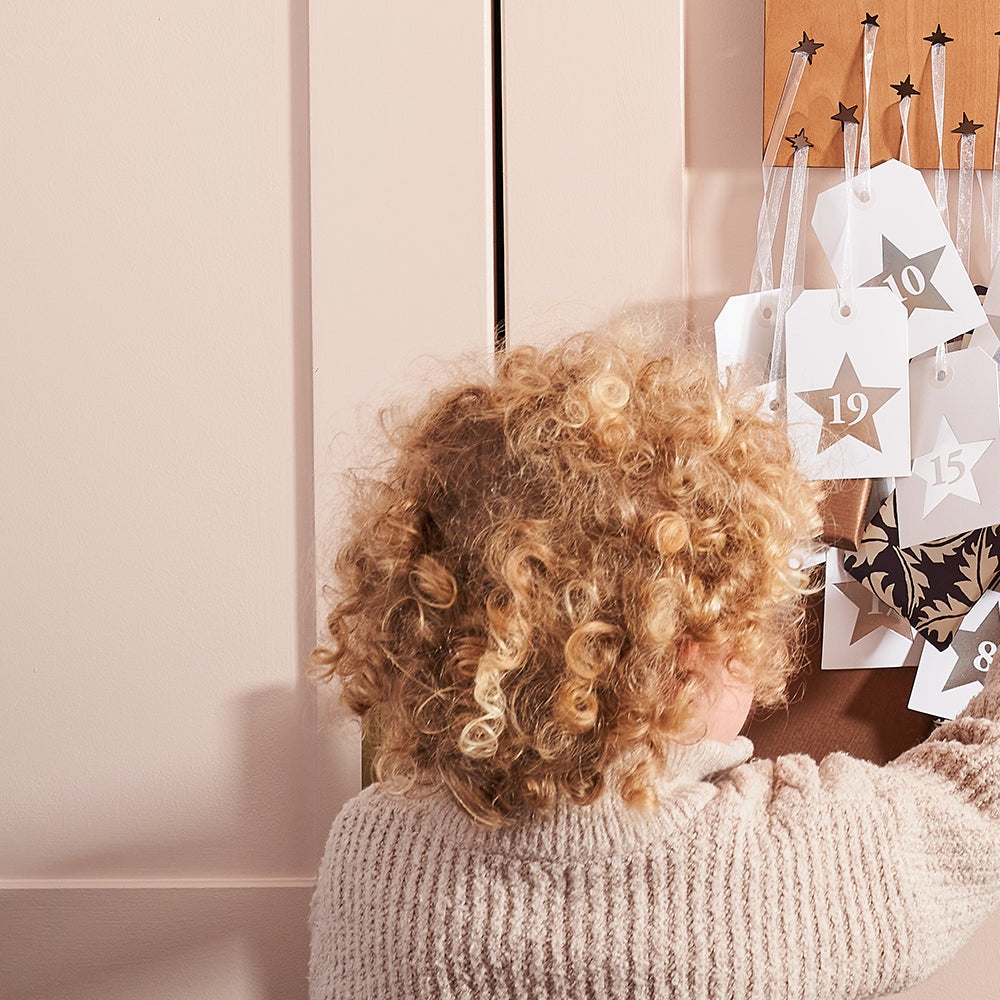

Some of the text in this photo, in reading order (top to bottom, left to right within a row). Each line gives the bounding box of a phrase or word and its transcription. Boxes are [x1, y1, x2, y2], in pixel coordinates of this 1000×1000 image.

[882, 264, 926, 303] 10
[828, 391, 869, 428] 19
[929, 449, 968, 486] 15
[972, 640, 997, 673] 8
